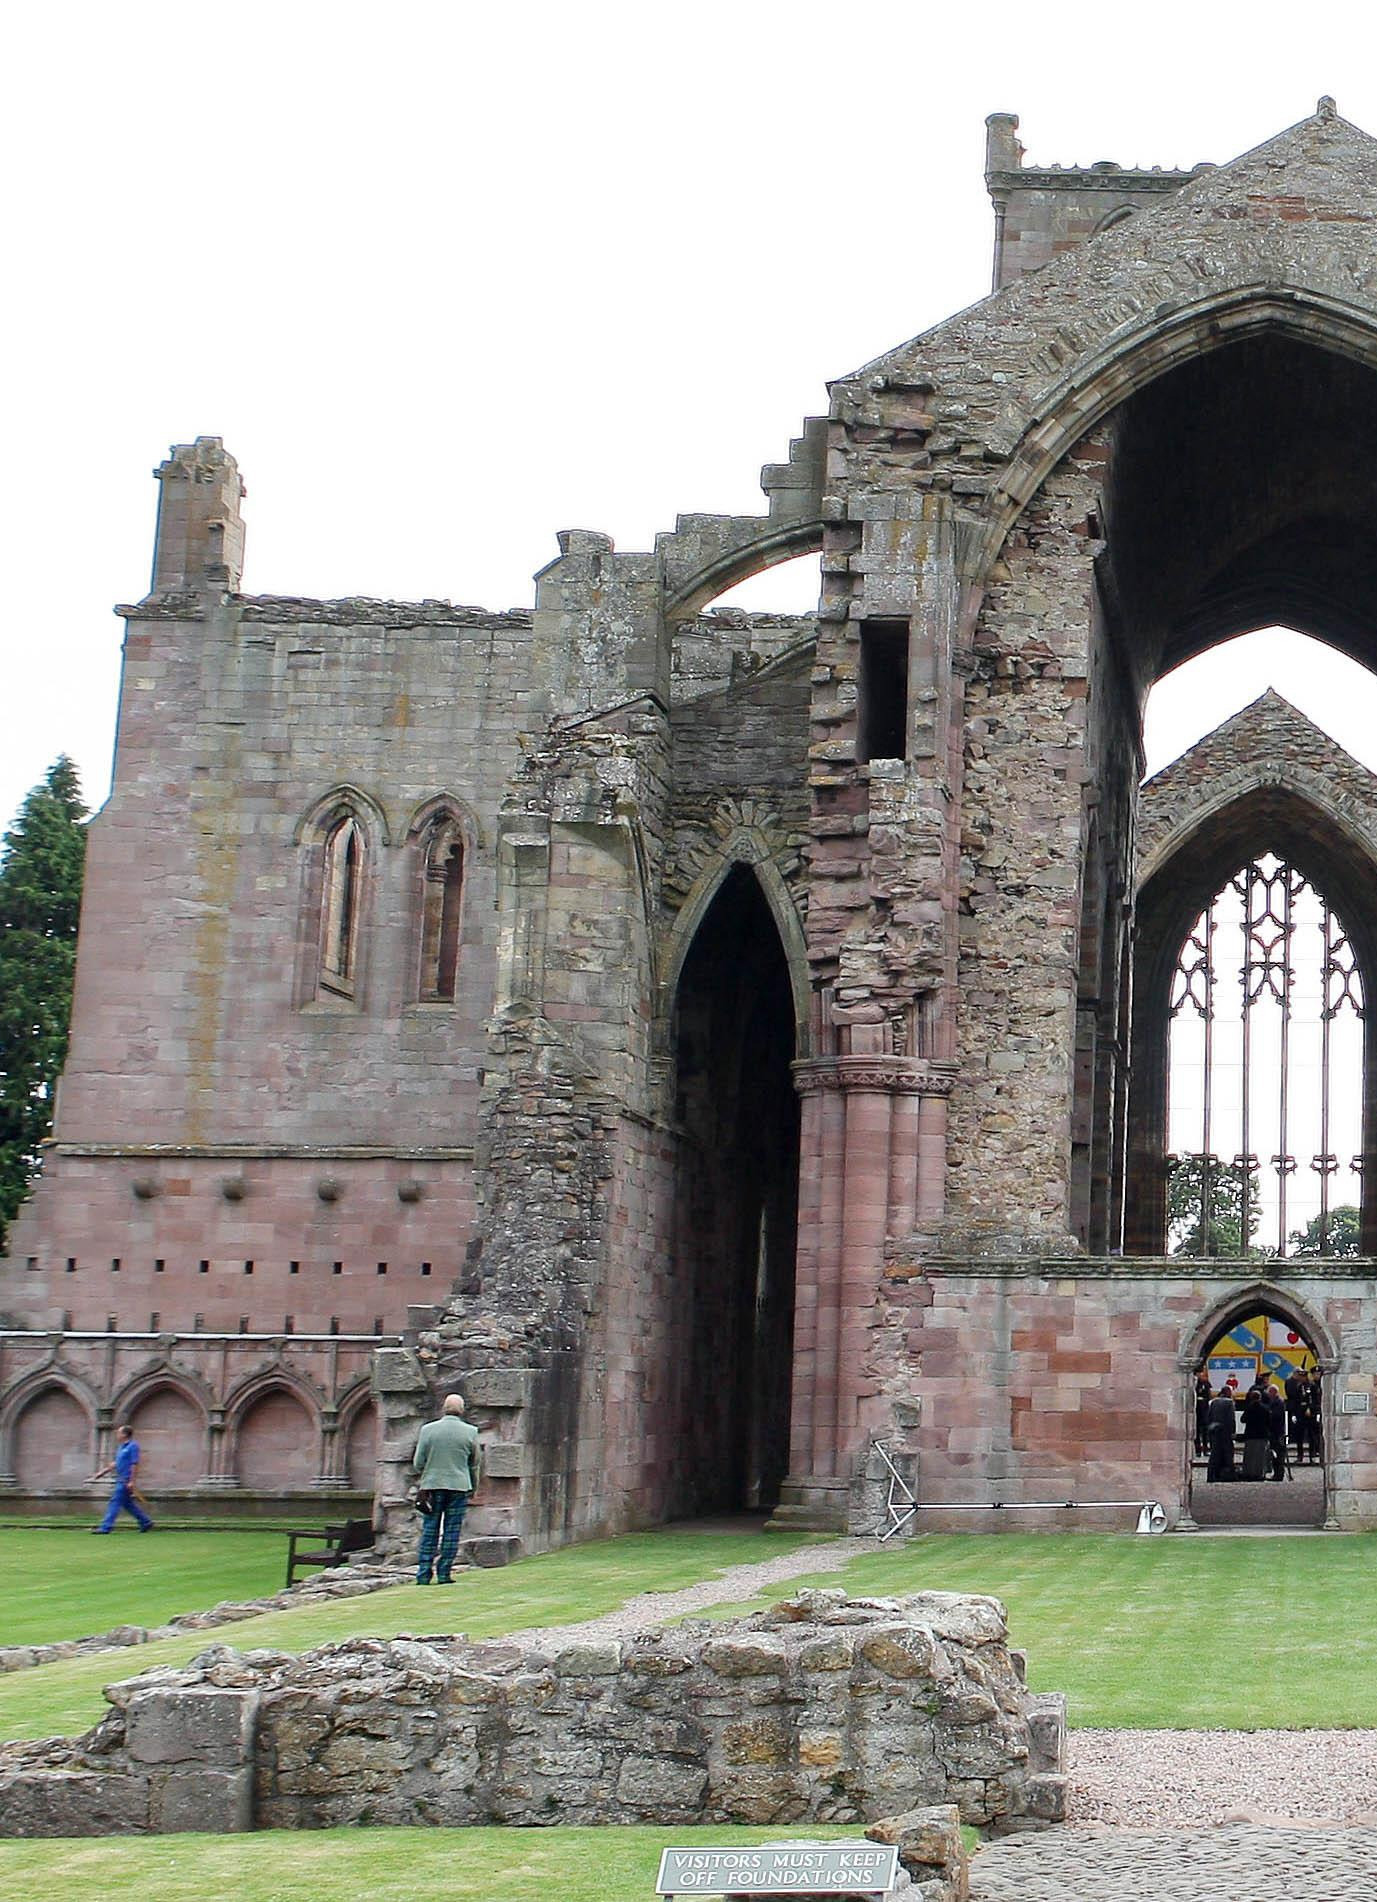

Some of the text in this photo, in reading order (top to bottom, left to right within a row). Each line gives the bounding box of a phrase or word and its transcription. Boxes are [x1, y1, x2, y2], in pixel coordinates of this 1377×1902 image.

[673, 1852, 887, 1869] VISITORS MUST KEEP
[679, 1869, 874, 1886] OFF FOUNDATIONS
